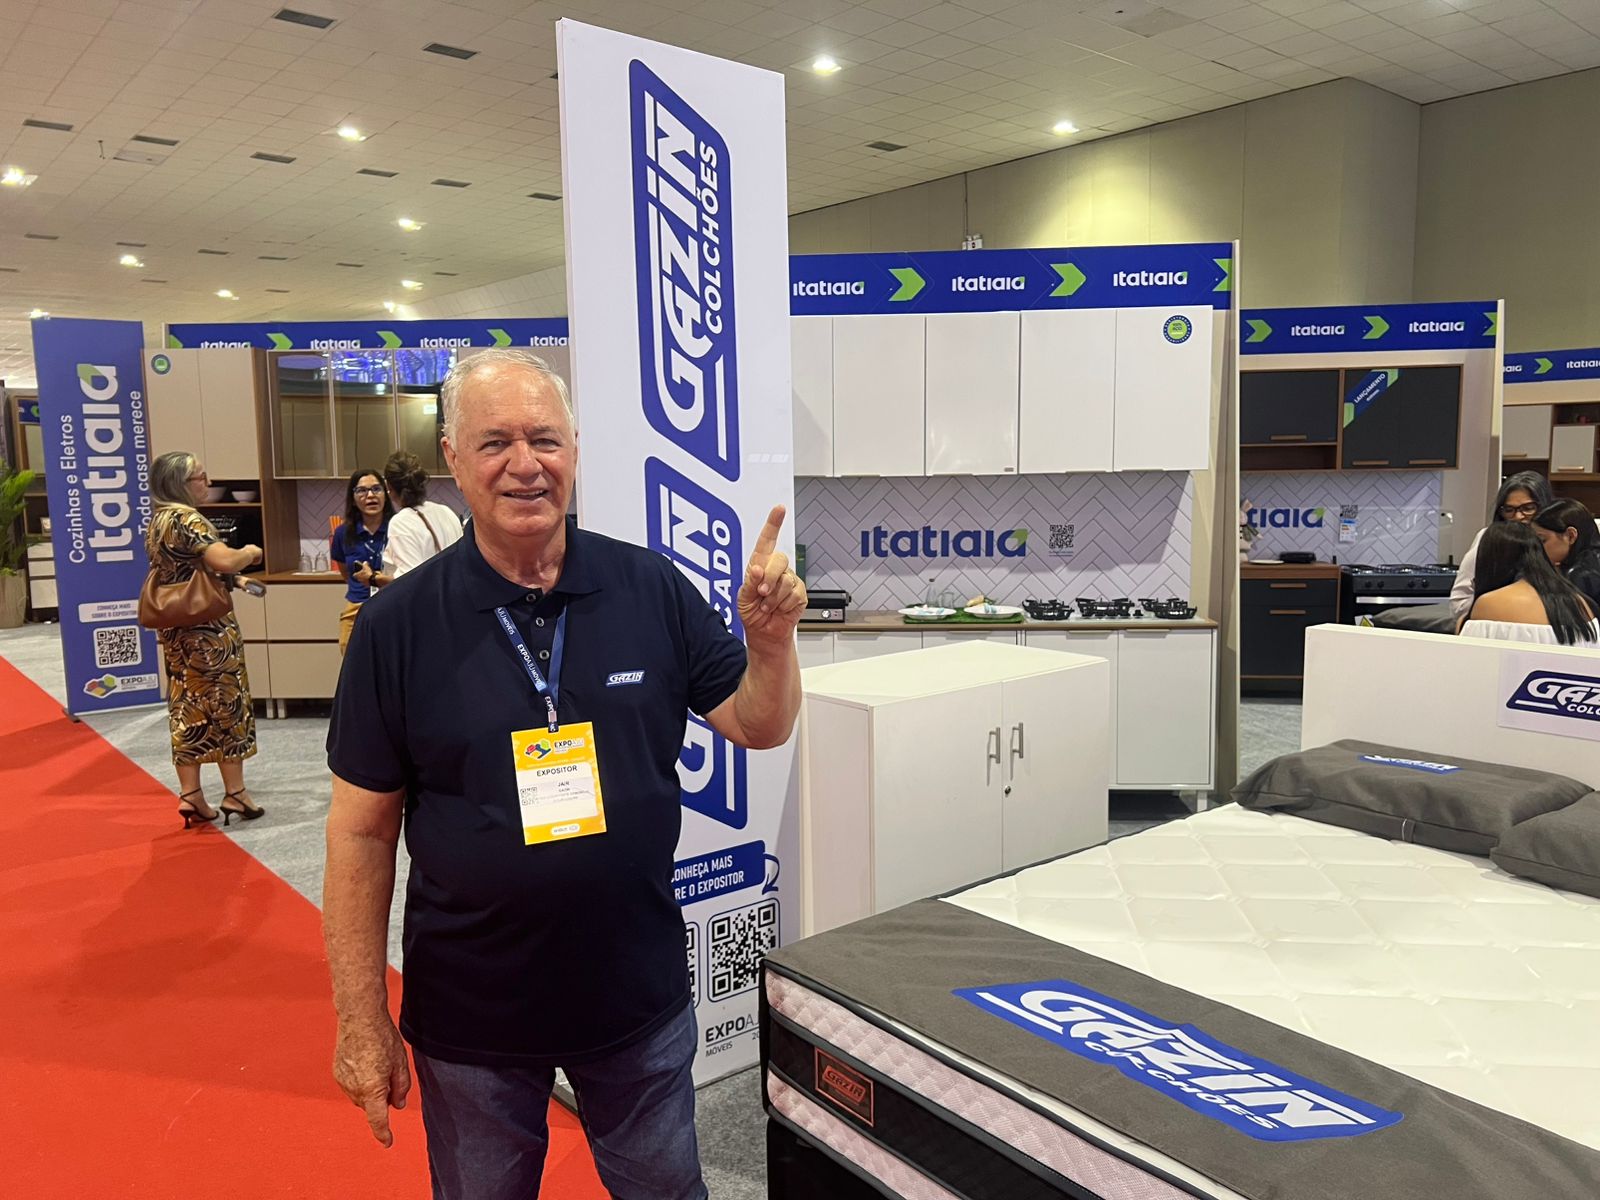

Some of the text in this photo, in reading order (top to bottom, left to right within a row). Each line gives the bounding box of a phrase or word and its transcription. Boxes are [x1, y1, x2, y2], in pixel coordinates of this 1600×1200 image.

[695, 140, 723, 335] COLCHÕES
[60, 414, 86, 564] Cozinhas e Eletros
[130, 390, 152, 535] Toda casa merece
[712, 519, 733, 634] CADO
[537, 765, 578, 777] EXPOSITOR
[671, 855, 733, 883] ONHEÇA MAIS
[688, 884, 695, 897] O
[698, 870, 744, 895] EXPOSITOR
